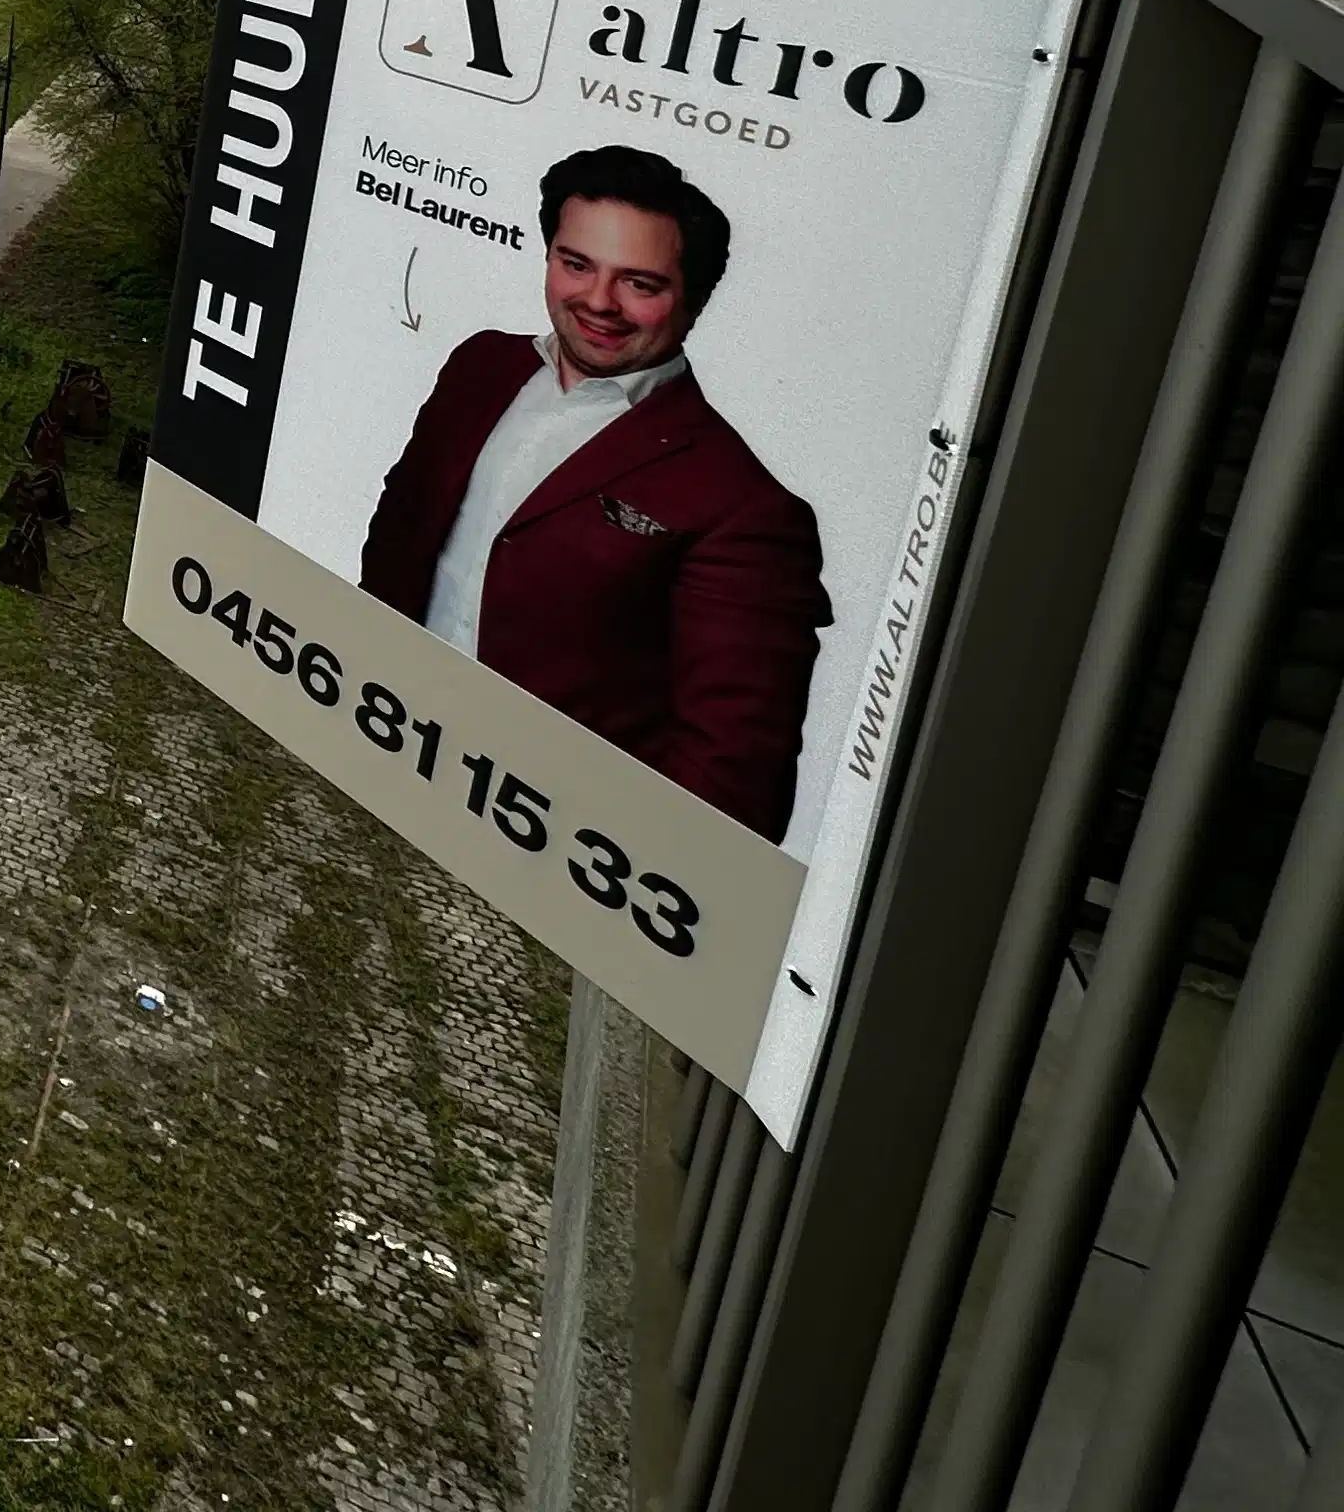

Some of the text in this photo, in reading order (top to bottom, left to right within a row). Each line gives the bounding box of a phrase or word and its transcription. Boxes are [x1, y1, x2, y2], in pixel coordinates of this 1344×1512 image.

[579, 76, 791, 150] VASTGOED
[362, 135, 488, 197] Meer info
[355, 170, 525, 251] Bel Laurent
[182, 278, 263, 407] TE
[172, 556, 700, 958] 0456 81 15 33
